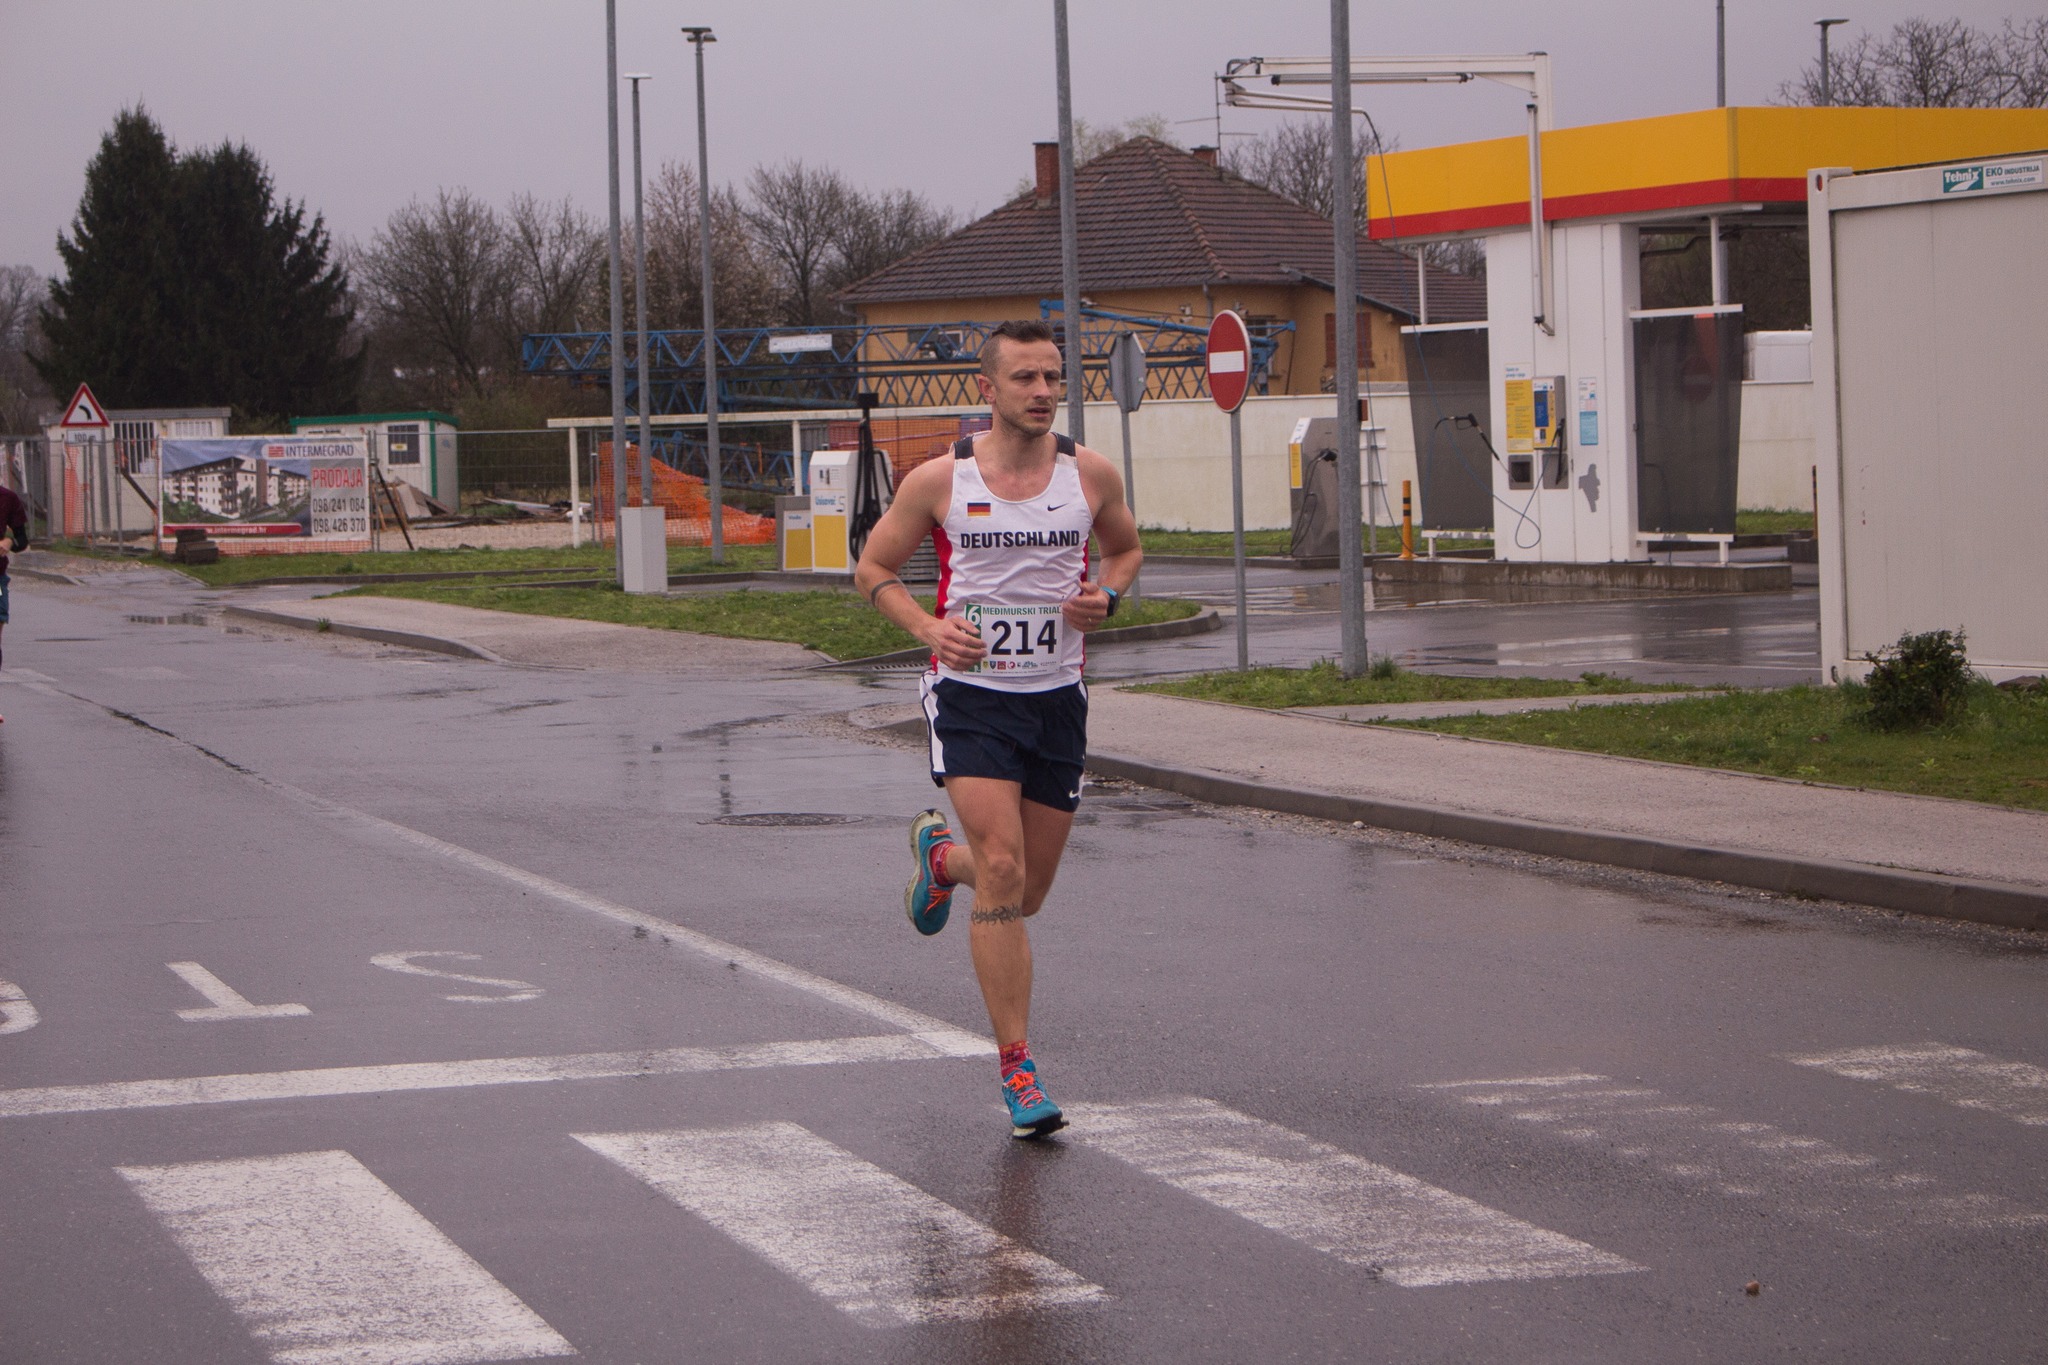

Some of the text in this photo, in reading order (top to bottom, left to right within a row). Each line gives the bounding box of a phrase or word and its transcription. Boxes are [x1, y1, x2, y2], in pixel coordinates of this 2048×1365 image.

[1944, 168, 1980, 183] Tehnix
[1985, 165, 2040, 177] EKO INDUSTRIJA
[286, 445, 354, 457] INTERMEGRAD
[312, 467, 363, 488] PRODAJA
[350, 517, 366, 532] 370
[960, 530, 1080, 549] DEUTSCHLAND
[982, 606, 1061, 615] MEĐIMURSKI TRIAL
[991, 619, 1057, 656] 214
